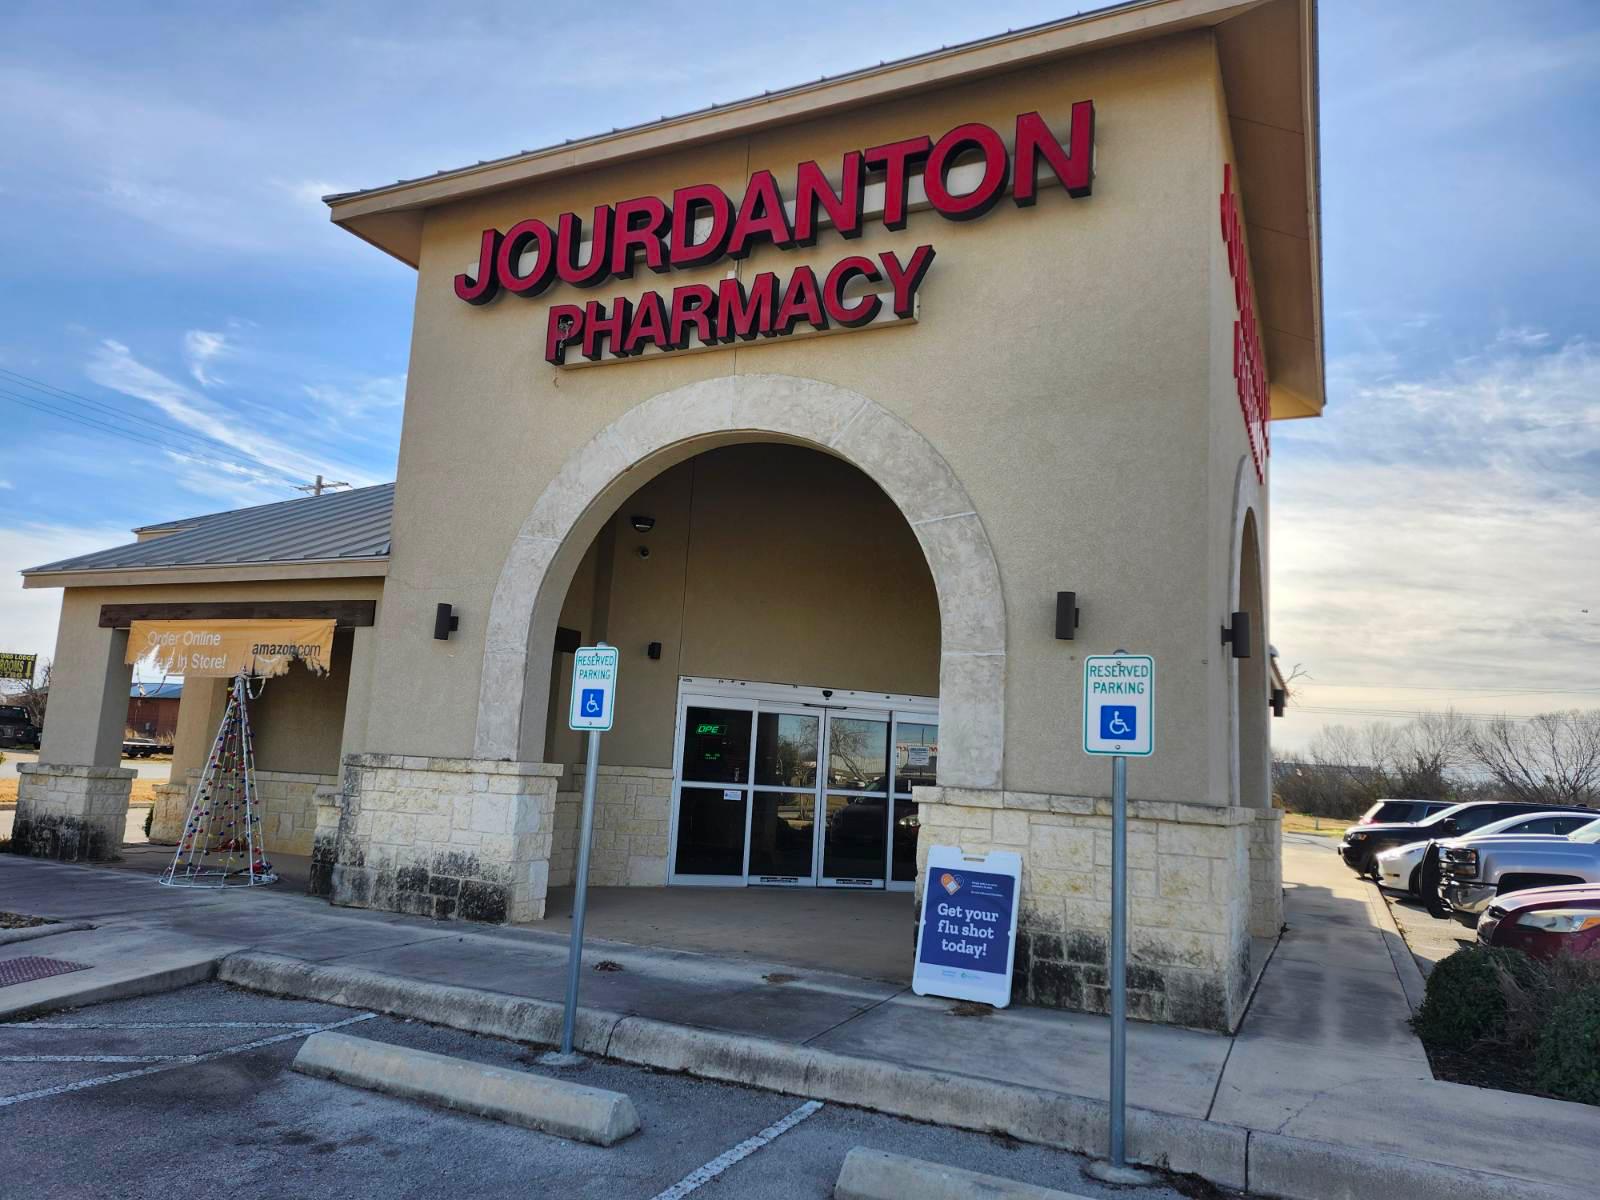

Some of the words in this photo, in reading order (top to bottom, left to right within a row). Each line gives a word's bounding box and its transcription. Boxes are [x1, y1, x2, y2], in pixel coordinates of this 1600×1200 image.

[454, 100, 1094, 304] JOURDANTON
[545, 244, 935, 366] PHARMACY
[147, 631, 180, 646] Order
[183, 631, 221, 646] Online
[252, 643, 321, 656] amazoncom
[191, 653, 227, 669] Store!
[576, 655, 614, 666] RESERVED
[579, 669, 611, 680] PARKING
[1089, 665, 1149, 677] RESERVED
[1093, 682, 1144, 694] PARKING
[698, 725, 721, 734] OPE
[937, 903, 962, 918] Get
[965, 908, 999, 922] your
[937, 920, 959, 934] flu
[961, 924, 995, 940] shot
[941, 938, 987, 959] today!
